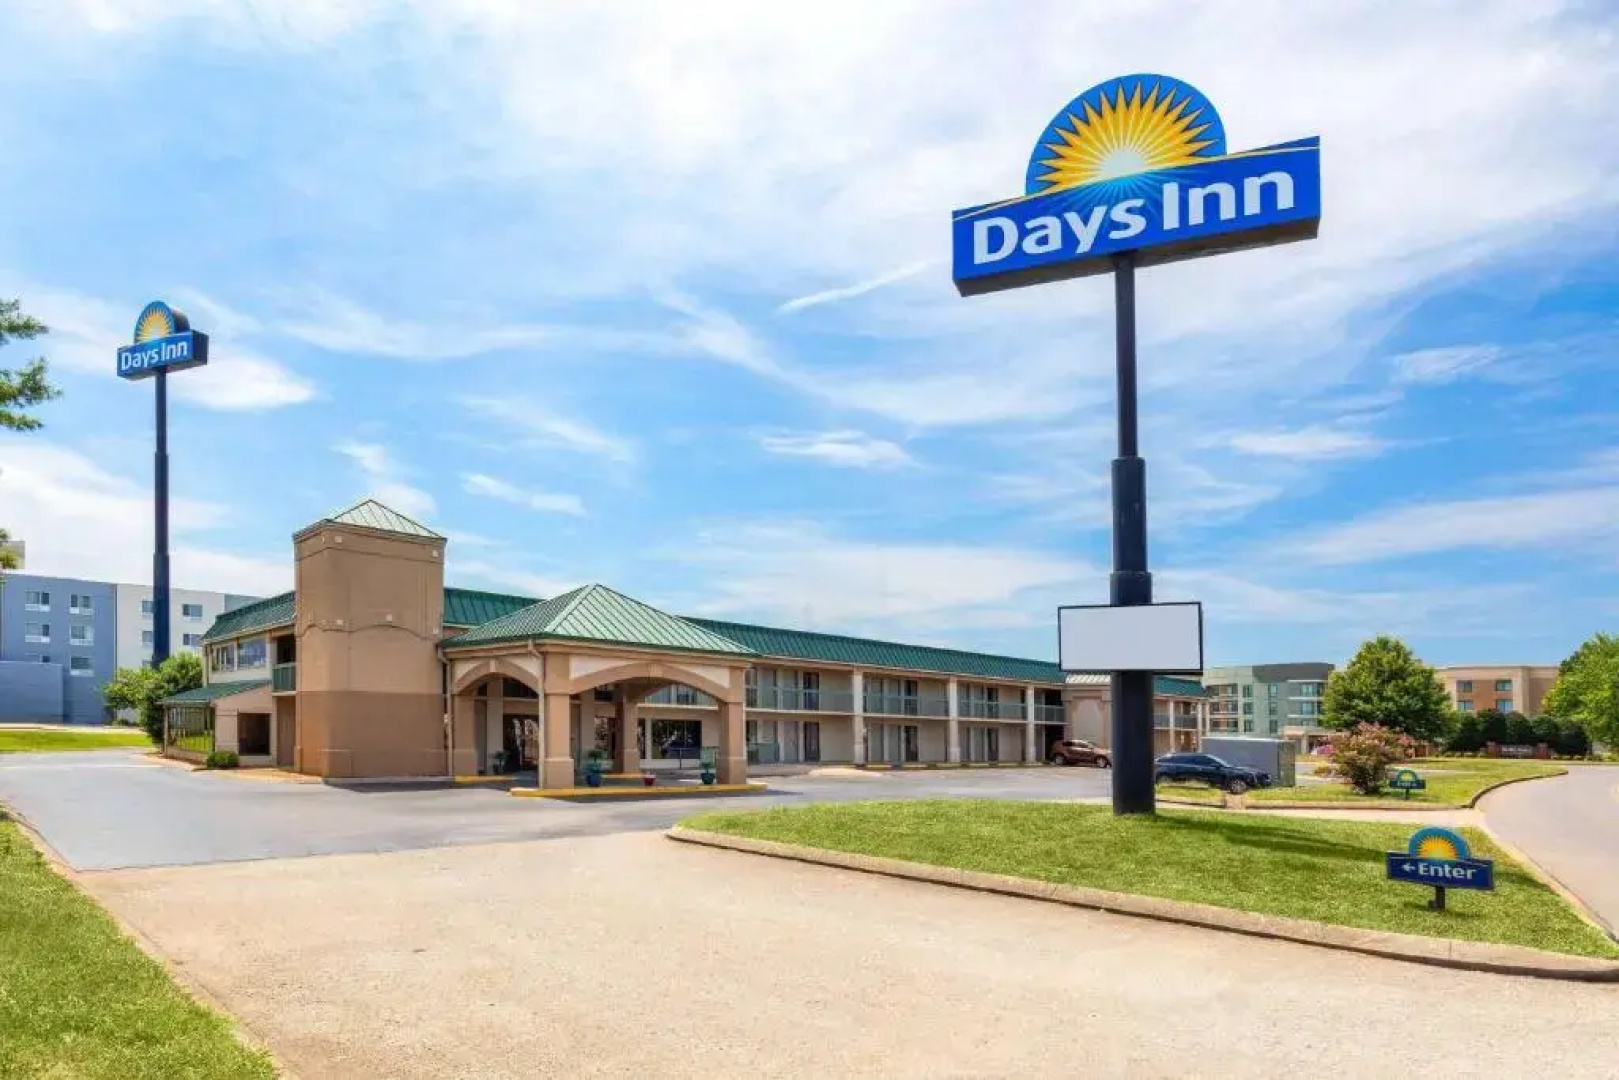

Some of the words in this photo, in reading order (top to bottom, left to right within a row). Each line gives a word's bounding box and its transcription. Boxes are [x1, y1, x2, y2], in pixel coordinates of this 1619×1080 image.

[973, 198, 1147, 265] Days
[1162, 170, 1295, 231] Inn
[121, 348, 159, 371] Days
[161, 341, 187, 361] Inn
[1418, 862, 1477, 880] Enter
